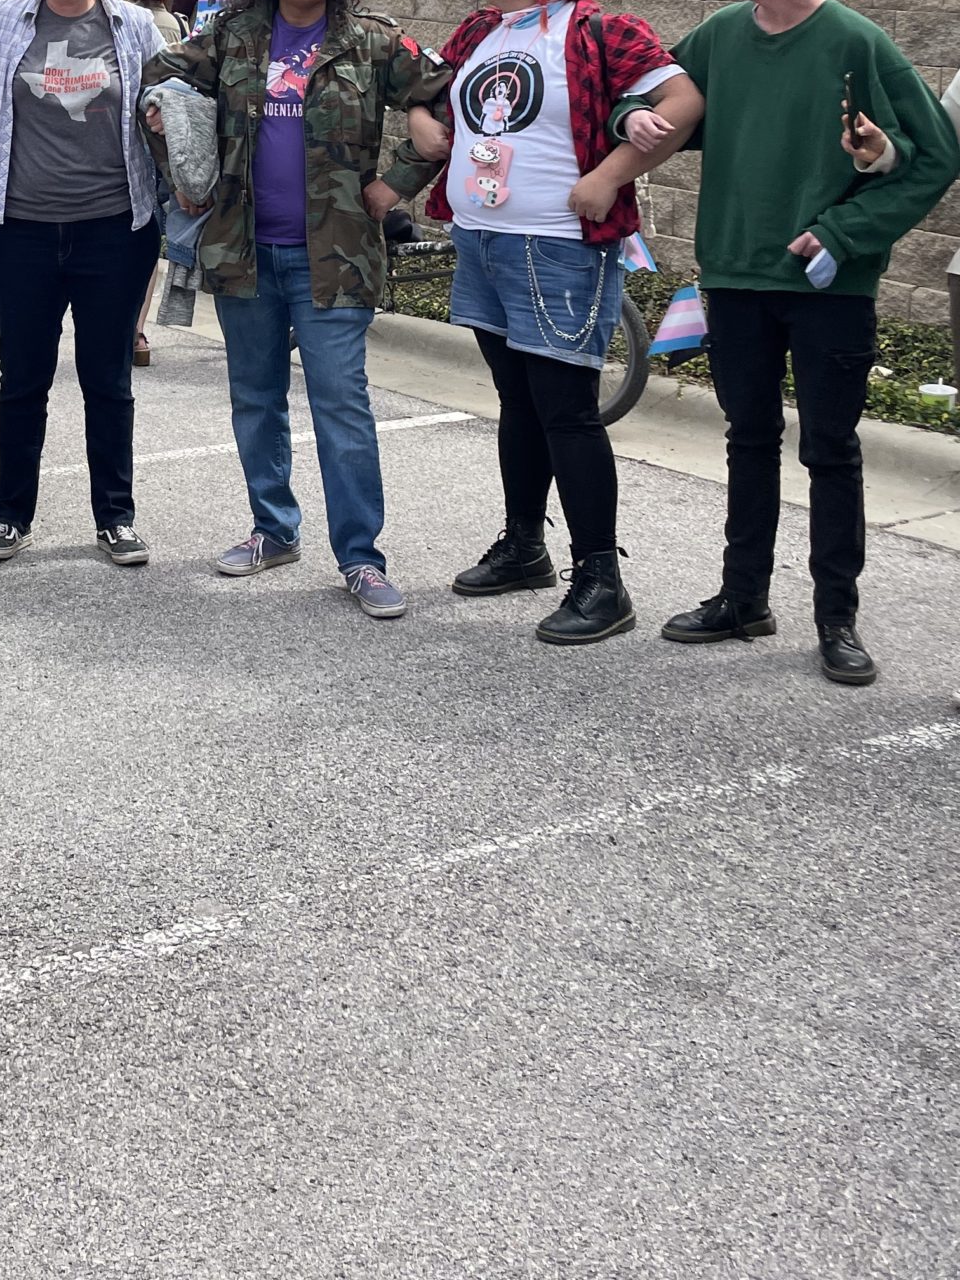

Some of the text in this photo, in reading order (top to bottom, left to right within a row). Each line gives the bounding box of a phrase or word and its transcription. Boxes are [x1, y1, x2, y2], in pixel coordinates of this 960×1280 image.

[45, 67, 72, 77] DON'T
[44, 72, 107, 85] DISCRIMINATE
[44, 84, 62, 93] Lone
[64, 84, 78, 93] Star
